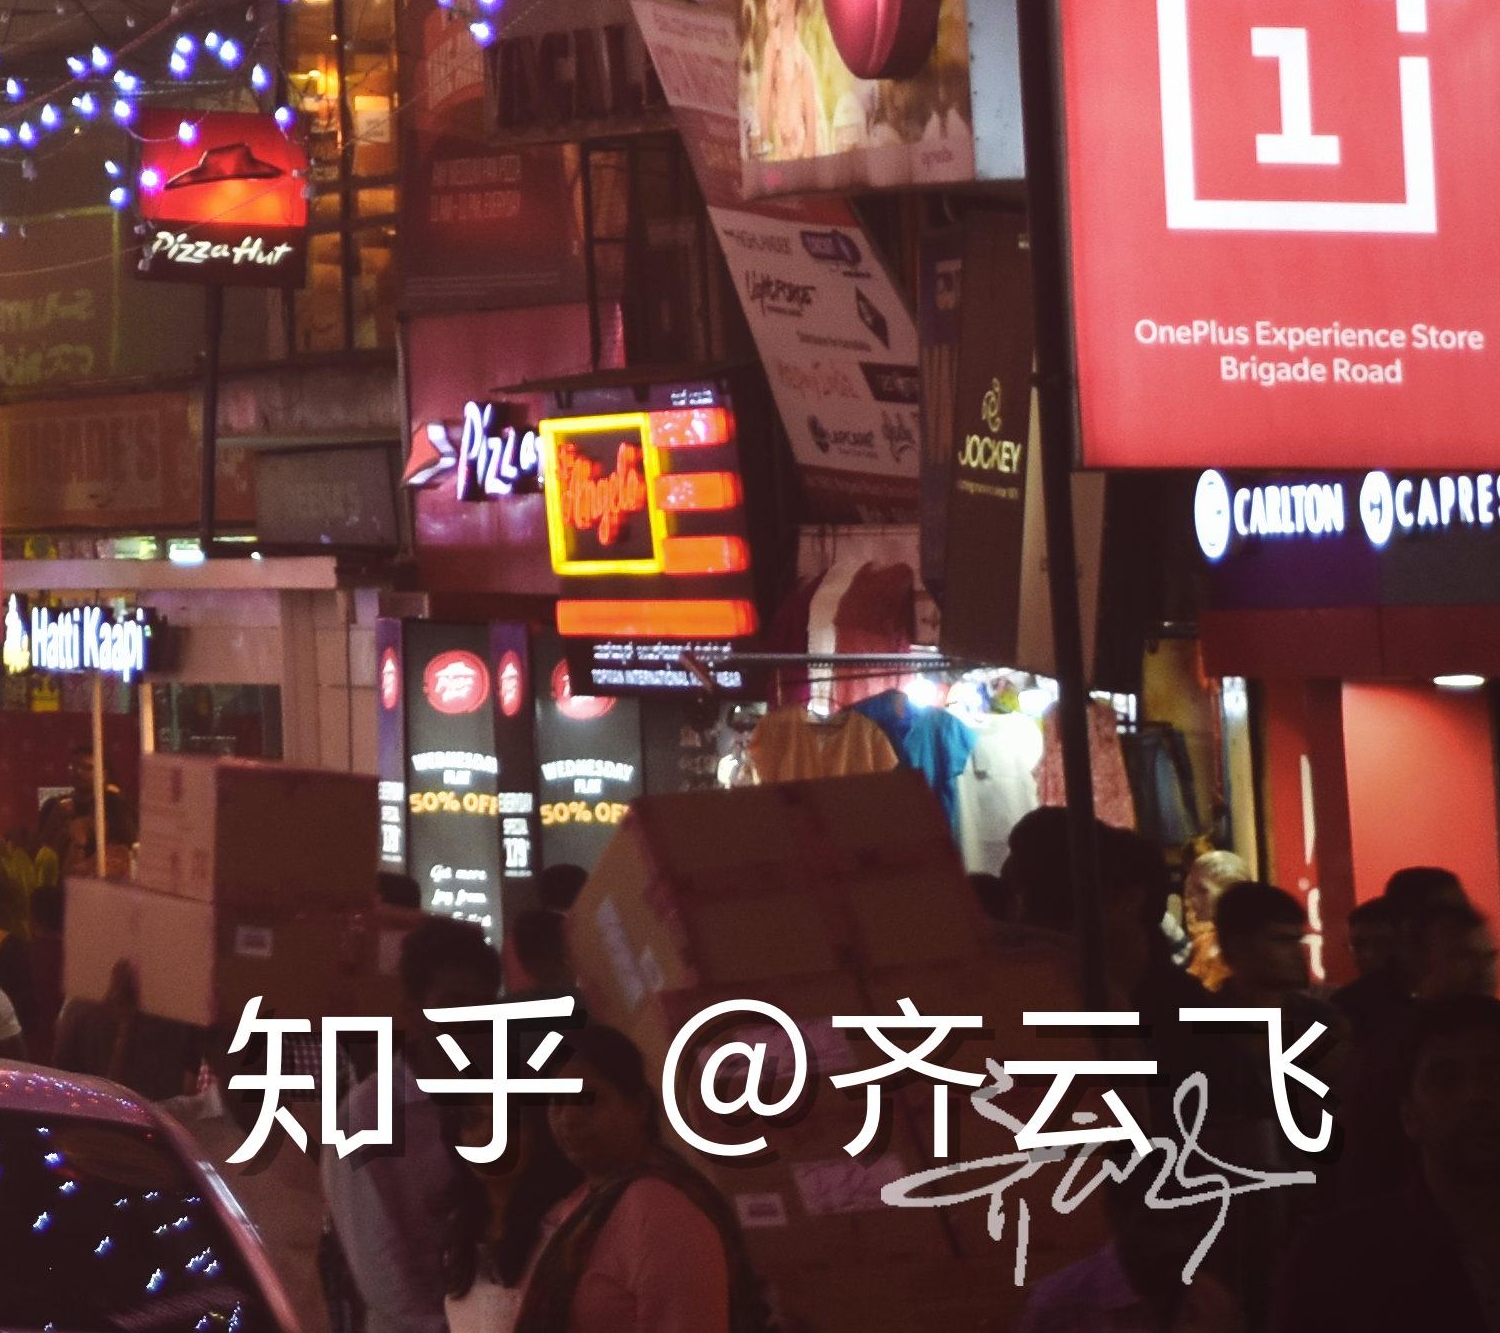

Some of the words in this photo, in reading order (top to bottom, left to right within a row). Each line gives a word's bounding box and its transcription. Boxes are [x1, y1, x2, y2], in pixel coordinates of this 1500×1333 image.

[151, 231, 231, 264] Pizza
[232, 236, 294, 267] Hut
[1134, 319, 1250, 345] OnePlus
[1255, 321, 1407, 352] Experience
[1411, 323, 1485, 350] Store
[1220, 356, 1327, 386] Brigade
[1332, 358, 1404, 384] Road
[958, 435, 1022, 474] JOCKEY
[1233, 483, 1345, 536] CARLTON
[1395, 473, 1500, 527] CAPRE
[31, 606, 80, 670] Hatti
[83, 605, 145, 683] Kaapi
[541, 758, 634, 783] WEDNESDAY
[409, 790, 461, 815] 50%
[540, 801, 592, 827] 50%
